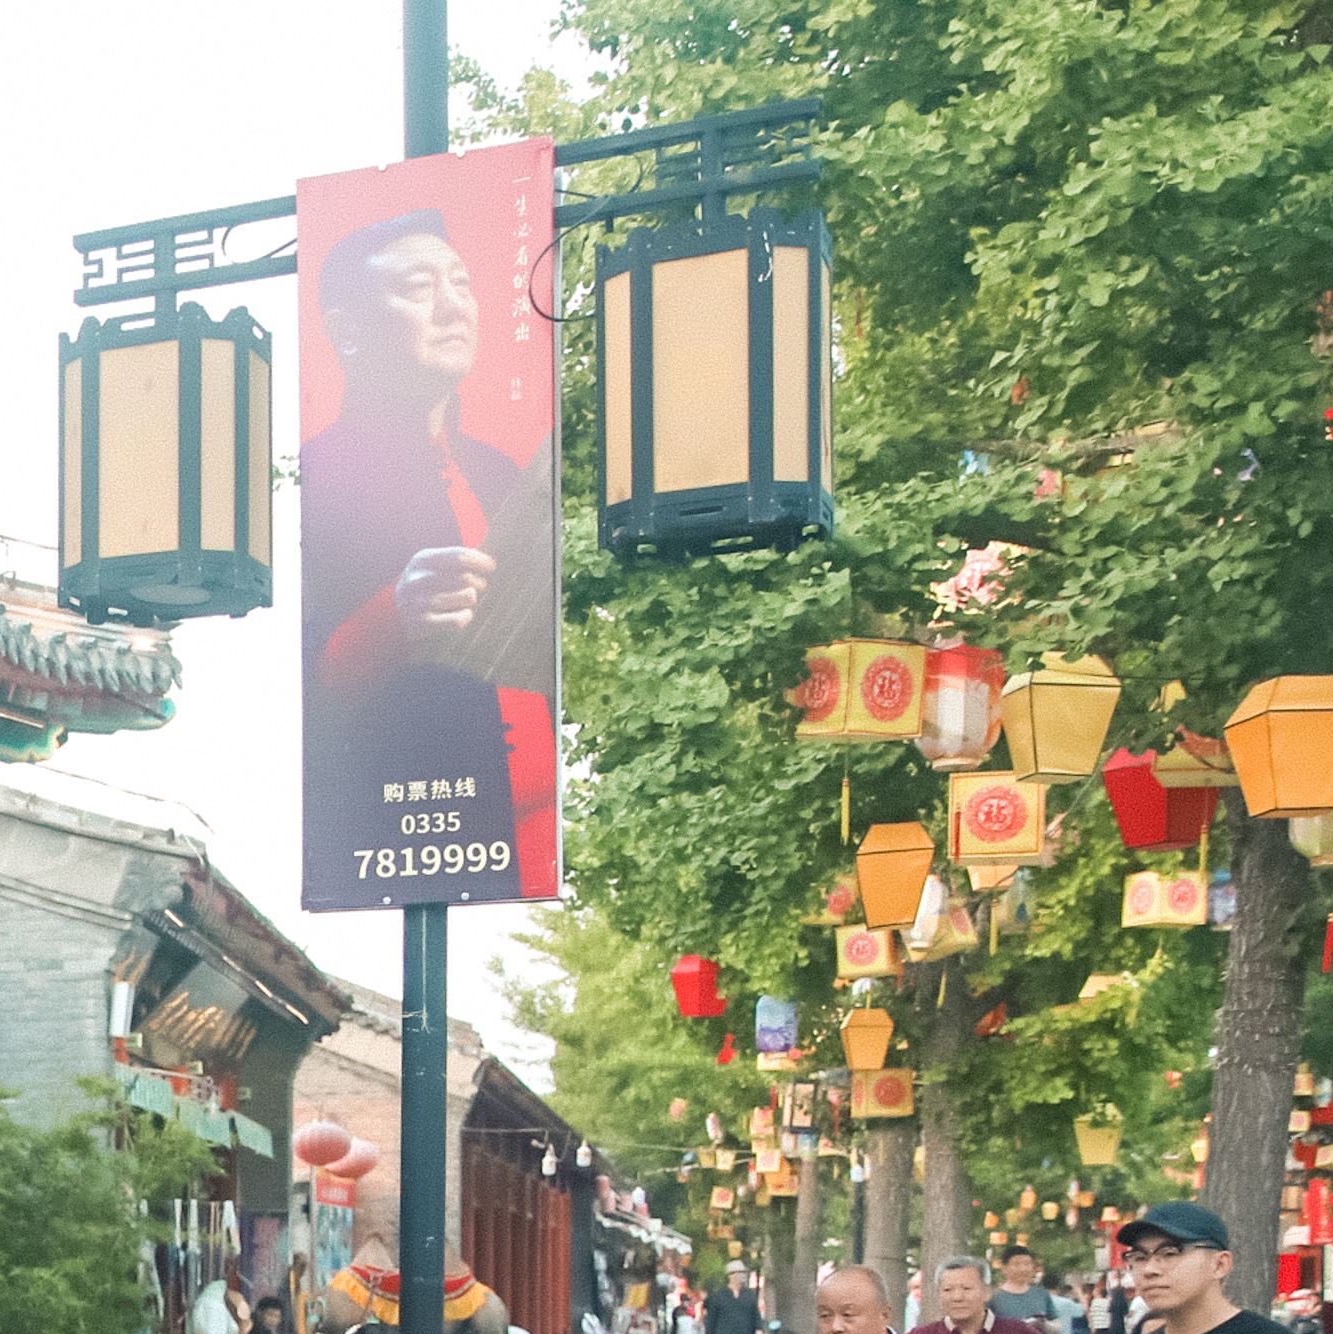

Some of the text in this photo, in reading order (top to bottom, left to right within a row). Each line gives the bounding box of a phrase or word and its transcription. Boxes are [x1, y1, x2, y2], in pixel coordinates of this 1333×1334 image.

[383, 777, 476, 802] 购票热线
[401, 811, 461, 835] 0335
[353, 840, 511, 879] 7819999
